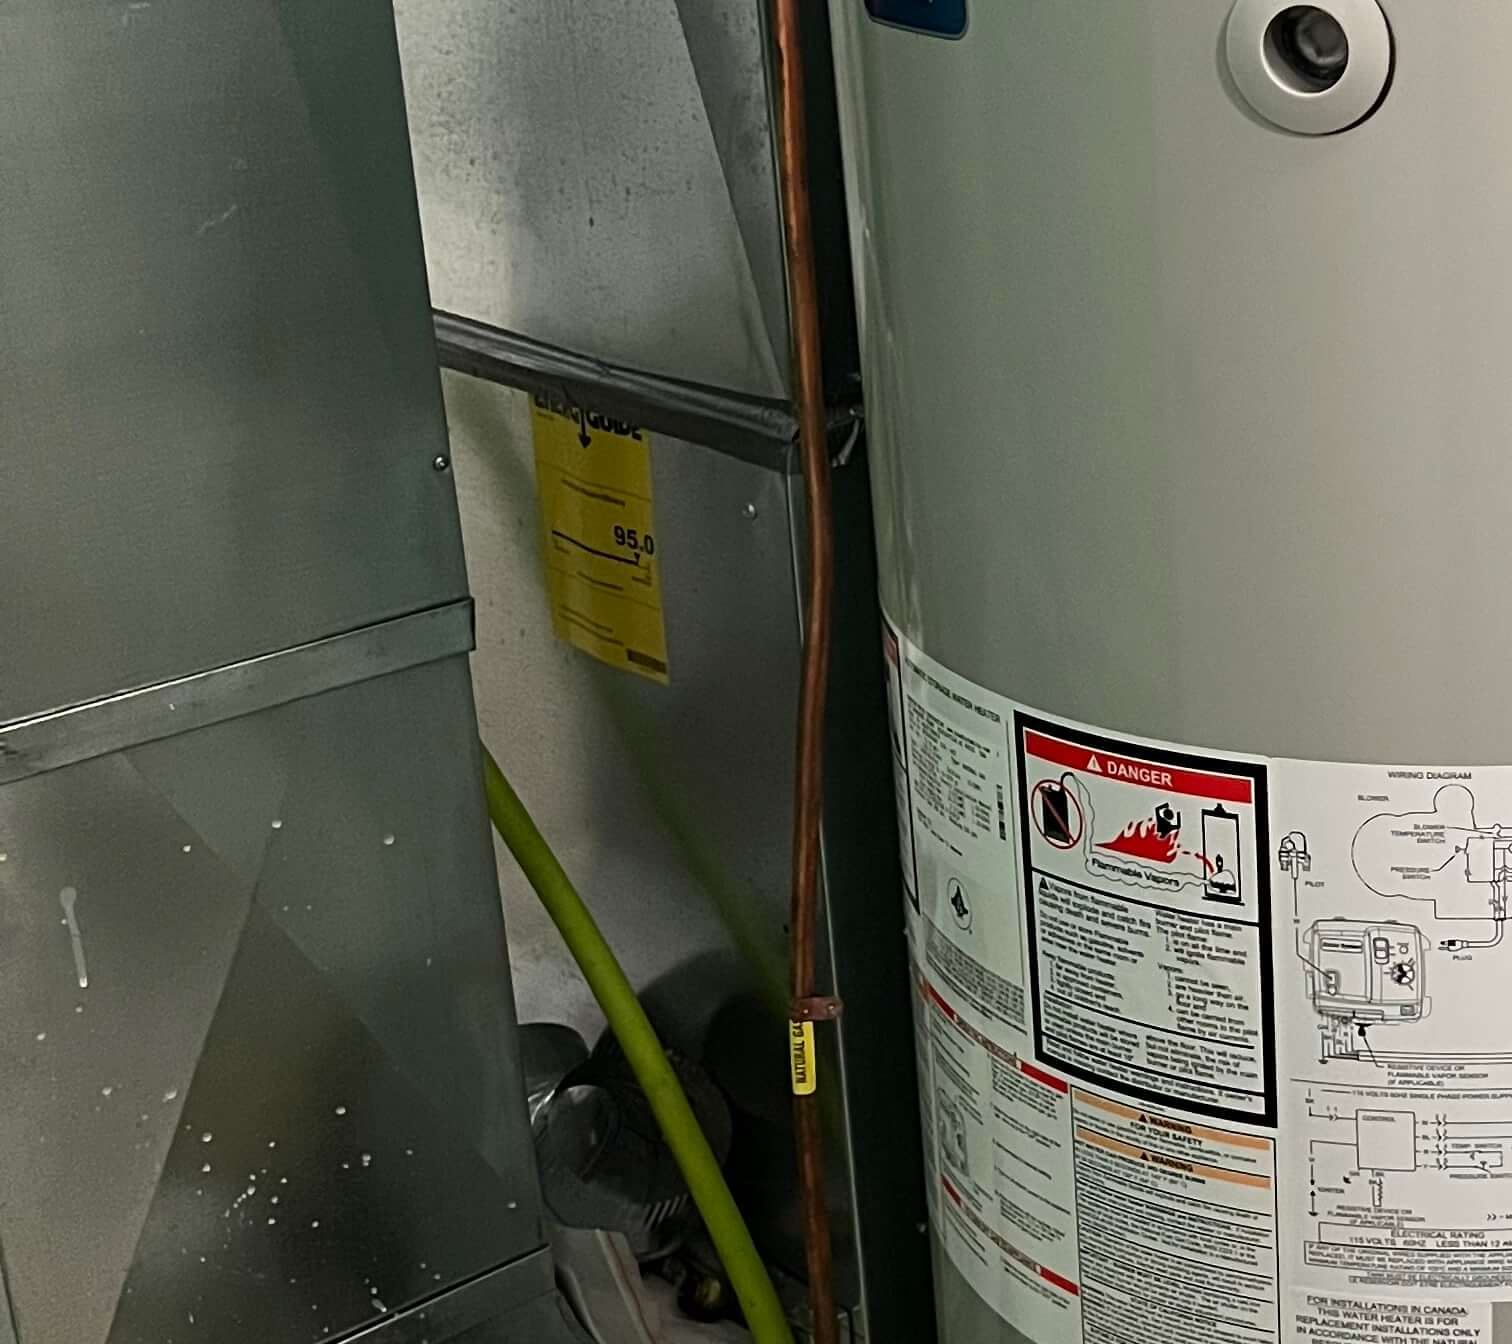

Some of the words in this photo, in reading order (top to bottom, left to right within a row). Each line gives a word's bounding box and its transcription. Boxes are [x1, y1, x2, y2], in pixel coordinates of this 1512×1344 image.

[613, 524, 654, 556] 95.0
[1107, 760, 1174, 787] DANGER
[1388, 771, 1424, 779] WIRING
[1426, 771, 1472, 779] DIAGRAM
[1092, 857, 1142, 877] Flammable
[1143, 870, 1180, 887] Vapors
[793, 1040, 807, 1084] NATURAL
[1149, 1115, 1192, 1134] WARNING
[1149, 1126, 1170, 1138] YOUR
[1172, 1133, 1202, 1146] SAFETY
[1151, 1153, 1194, 1173] WARNING
[1366, 1237, 1396, 1246] VOLTS
[1391, 1229, 1447, 1238] ELECTRICAL
[1450, 1231, 1485, 1239] RATING
[1307, 1296, 1328, 1305] FOR
[1331, 1298, 1408, 1312] INSTALLATIONS
[1411, 1304, 1421, 1313] IN
[1296, 1314, 1368, 1331] REPLACEMENT
[1372, 1323, 1449, 1336] INSTALLATIONS
[1453, 1328, 1480, 1336] ONLY
[1318, 1307, 1340, 1317] THIS
[1343, 1310, 1379, 1321] WATER
[1382, 1313, 1421, 1324] HEATER
[1425, 1316, 1433, 1324] IS
[1437, 1317, 1458, 1326] FOR
[1297, 1325, 1306, 1334] IN
[1309, 1327, 1378, 1343] ACCORDANCE
[1382, 1336, 1407, 1344] WITH
